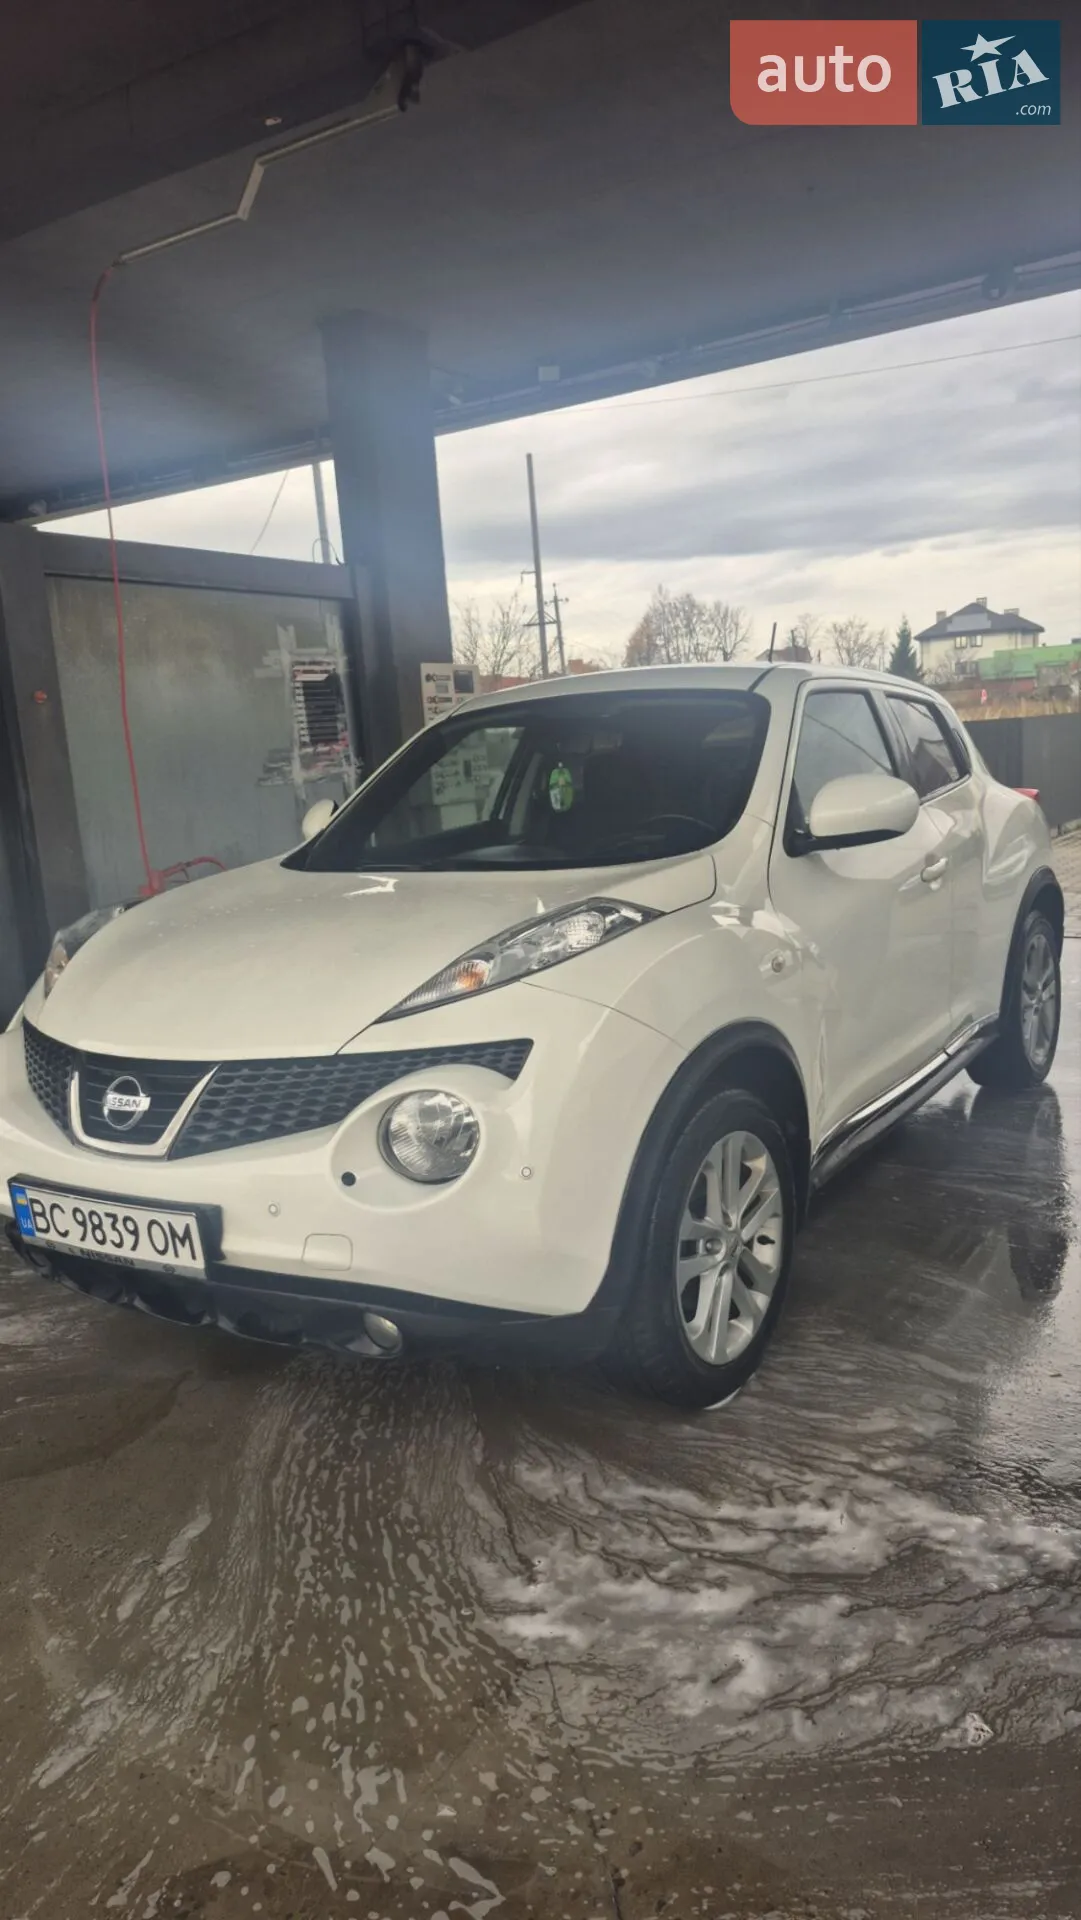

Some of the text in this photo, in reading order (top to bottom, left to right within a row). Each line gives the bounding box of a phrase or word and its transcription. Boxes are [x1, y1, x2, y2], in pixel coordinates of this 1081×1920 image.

[21, 1217, 34, 1230] UA
[29, 1198, 197, 1261] BC 9839 OM
